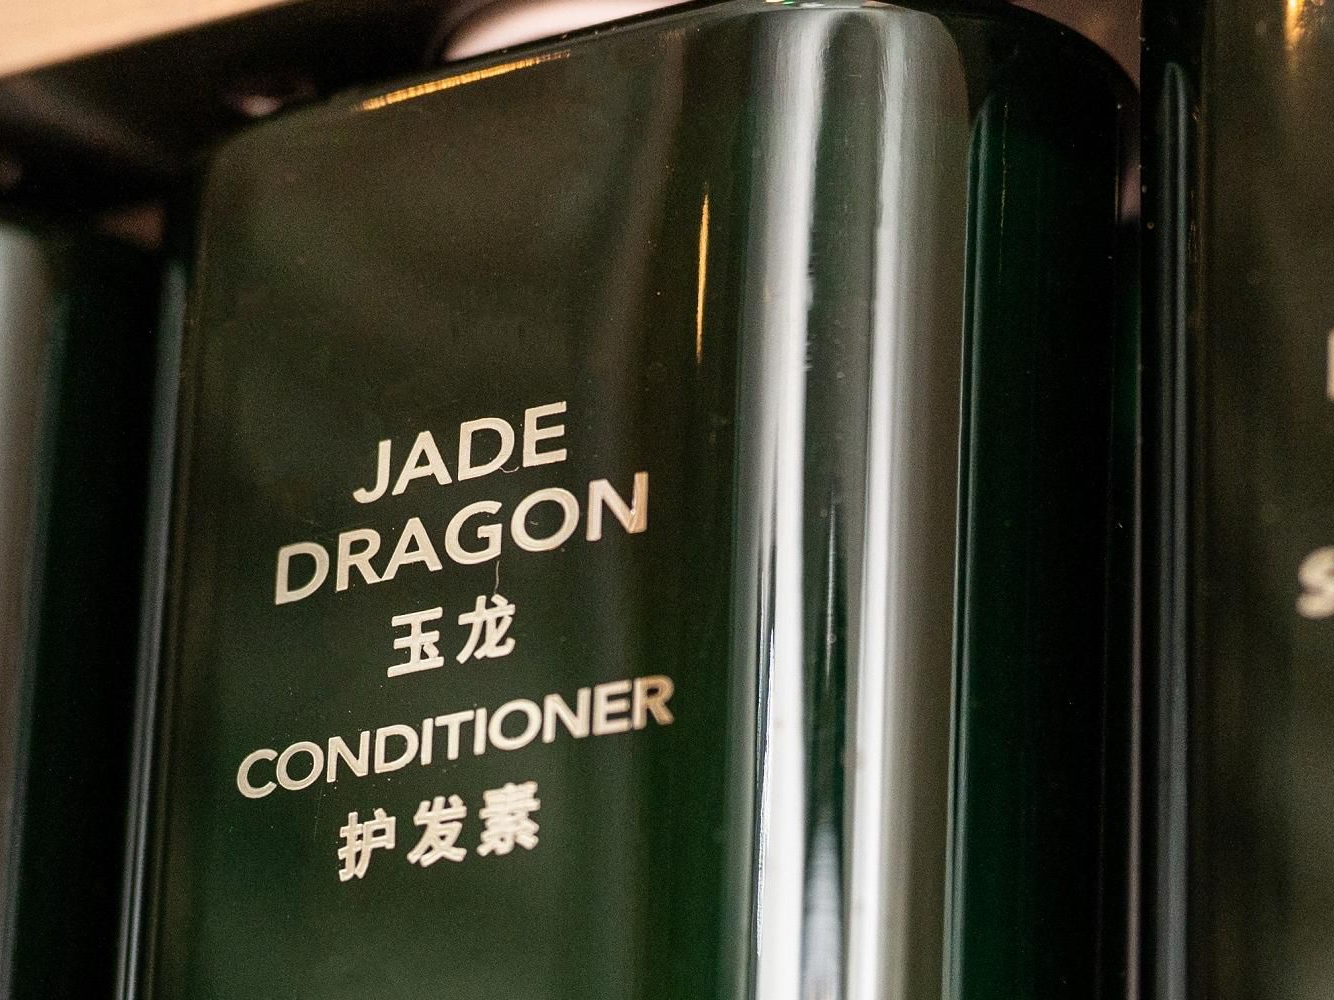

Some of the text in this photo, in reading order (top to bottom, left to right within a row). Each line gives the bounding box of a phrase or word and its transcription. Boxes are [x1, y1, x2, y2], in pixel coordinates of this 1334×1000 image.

[353, 401, 567, 503] JADE
[275, 472, 649, 605] DRAGON
[387, 594, 515, 677] 玉龙
[237, 675, 675, 799] CONDITIONER
[338, 781, 540, 882] 护发素
